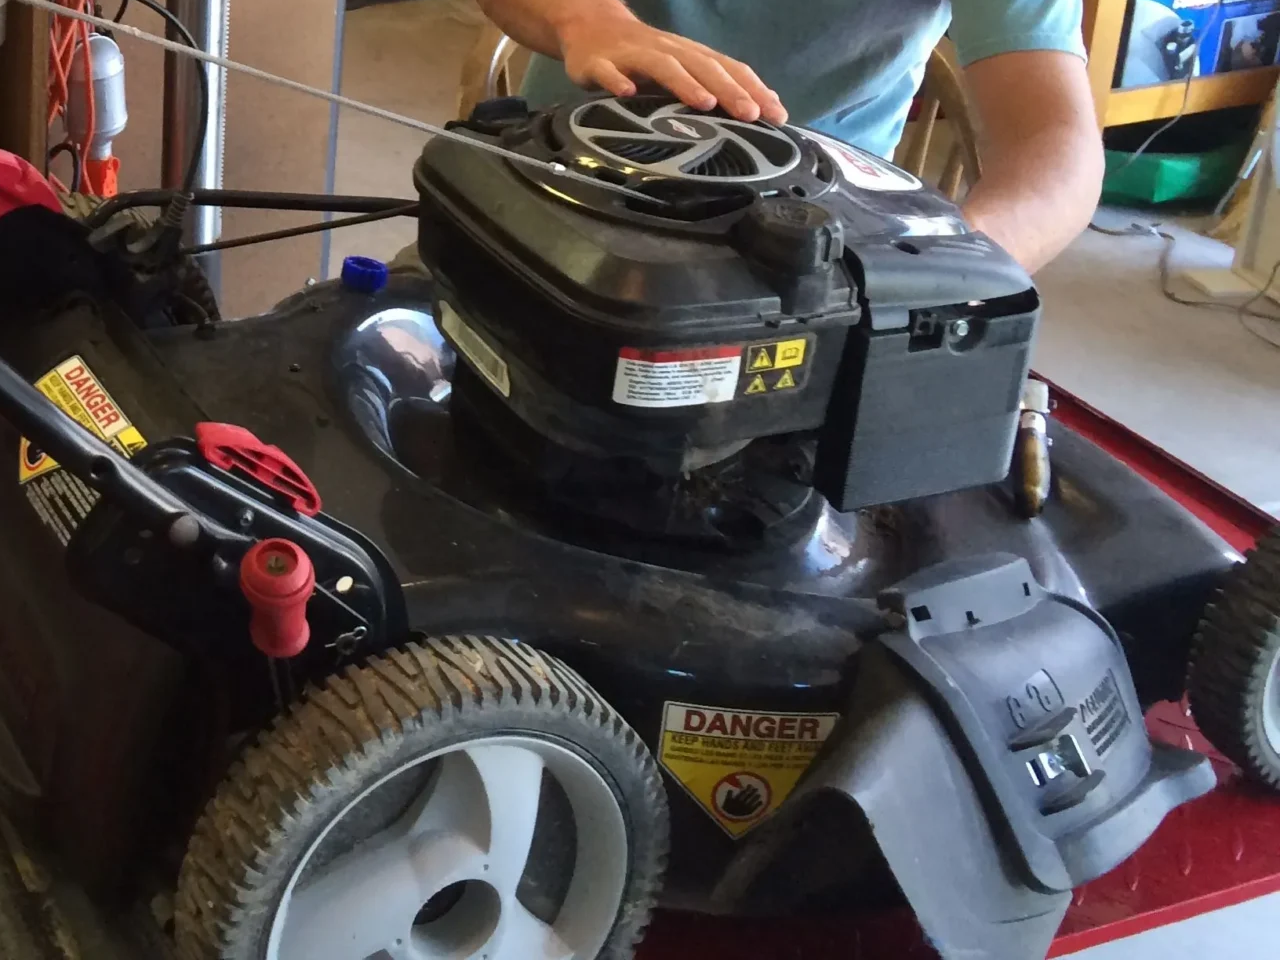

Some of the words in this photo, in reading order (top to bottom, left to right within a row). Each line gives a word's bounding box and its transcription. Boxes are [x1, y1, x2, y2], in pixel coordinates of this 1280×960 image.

[64, 365, 120, 429] DANGER
[671, 733, 699, 745] KEEP
[683, 709, 820, 740] DANGER
